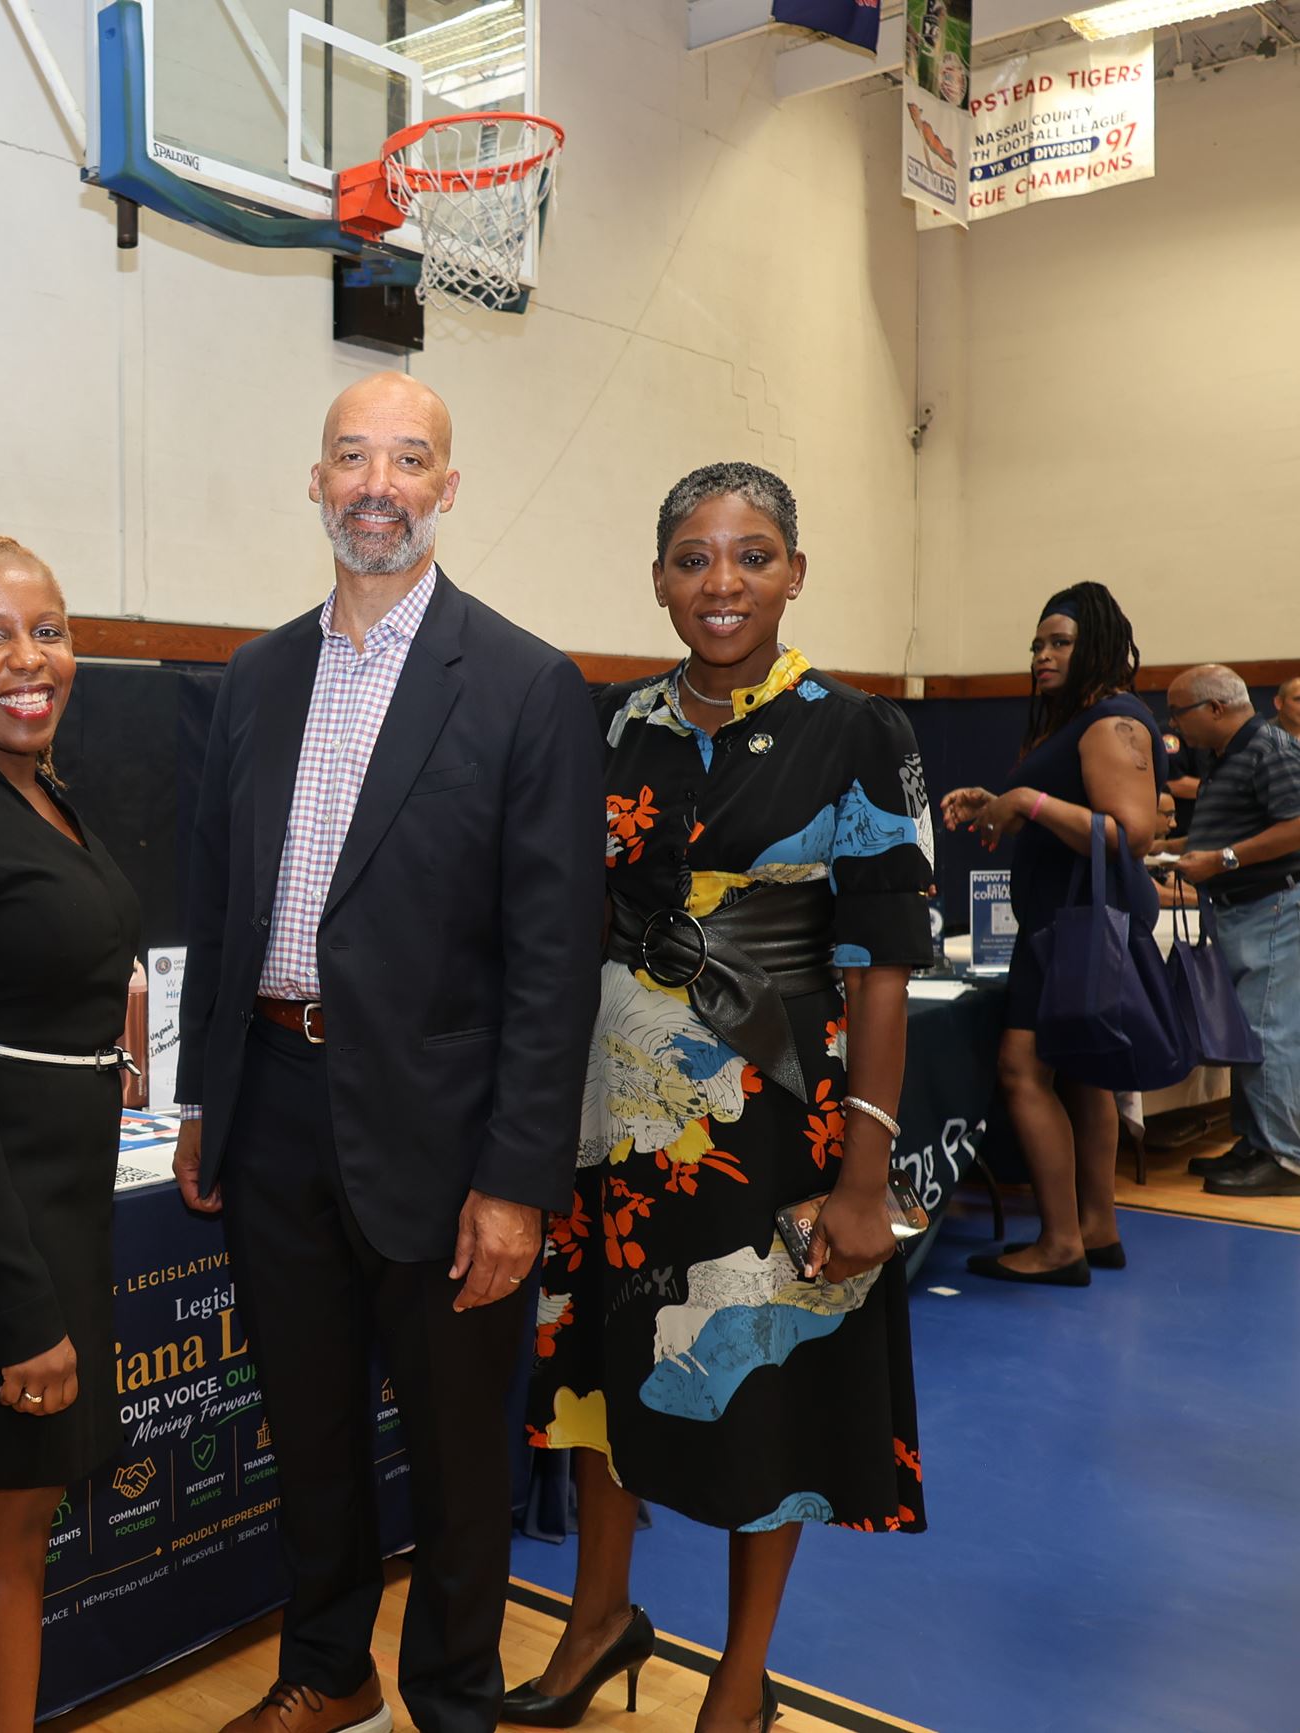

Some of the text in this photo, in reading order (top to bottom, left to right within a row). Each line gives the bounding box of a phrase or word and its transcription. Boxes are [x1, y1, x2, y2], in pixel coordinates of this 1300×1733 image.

[969, 63, 1143, 118] PSTEAD TIGERS
[975, 105, 1093, 147] NASSAU COUNTY
[996, 127, 1062, 157] FOOTBALL
[1072, 111, 1128, 135] LEAGUE
[1105, 121, 1138, 153] 97
[153, 142, 200, 171] SPALDING
[1034, 139, 1093, 161] DIVISION
[969, 152, 1134, 208] GUE CHAMPIONS
[973, 874, 1001, 883] NOW
[175, 1282, 236, 1322] Legisl
[114, 1307, 249, 1395] iana L
[120, 1396, 160, 1424] OUR
[164, 1376, 222, 1409] VOICE.
[131, 1414, 196, 1448] Moving
[186, 1472, 226, 1496] INTEGRITY
[190, 1488, 222, 1508] ALWAYS
[108, 1498, 161, 1526] COMMUNITY
[115, 1516, 157, 1538] FOCUSED
[171, 1522, 220, 1552] PROUDLY
[237, 1522, 270, 1543] JERICHO
[181, 1540, 225, 1567] HICKSVILLE
[82, 1565, 170, 1608] HEMPSTEAD VILLAGE
[41, 1608, 69, 1627] PLACE
